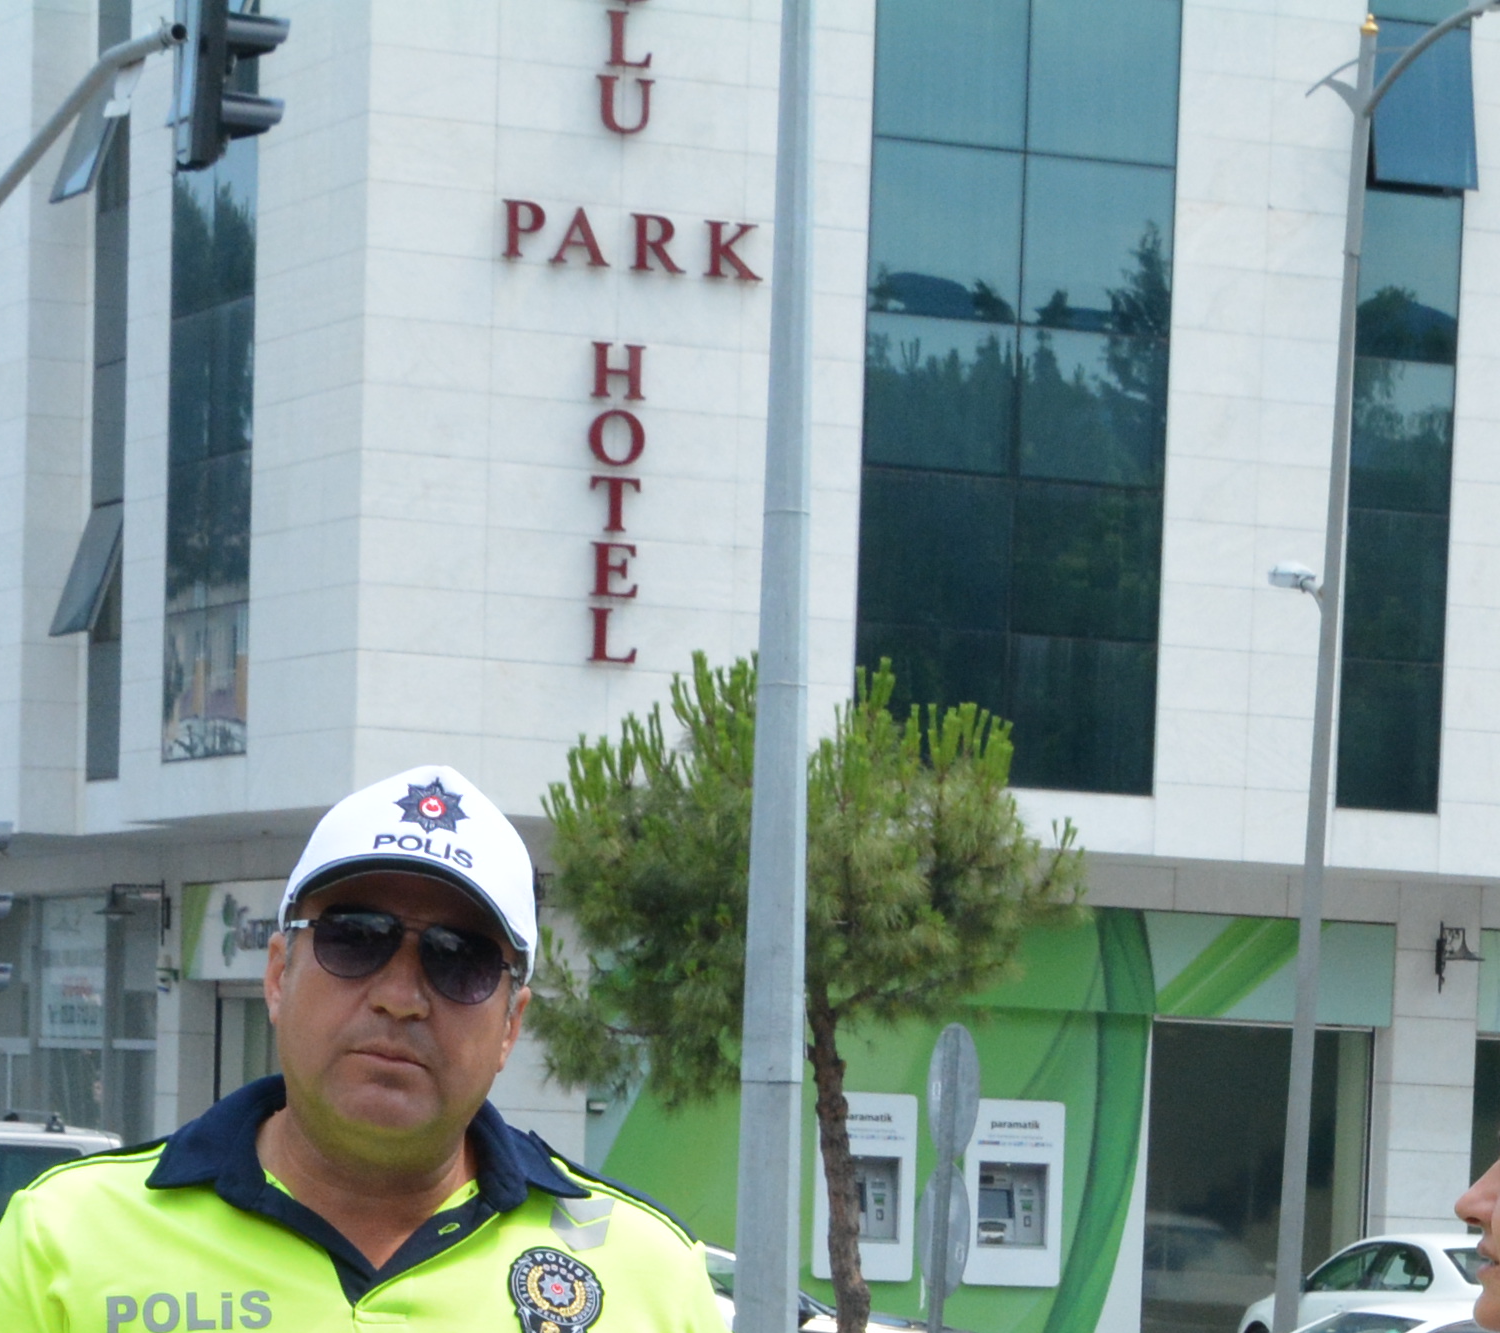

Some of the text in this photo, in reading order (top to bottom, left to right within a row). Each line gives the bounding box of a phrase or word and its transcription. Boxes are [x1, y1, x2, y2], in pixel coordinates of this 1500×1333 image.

[595, 0, 656, 134] LU
[501, 198, 763, 282] PARK
[586, 341, 647, 664] HOTEL
[847, 1113, 893, 1124] aramatik
[990, 1119, 1040, 1131] paramatik
